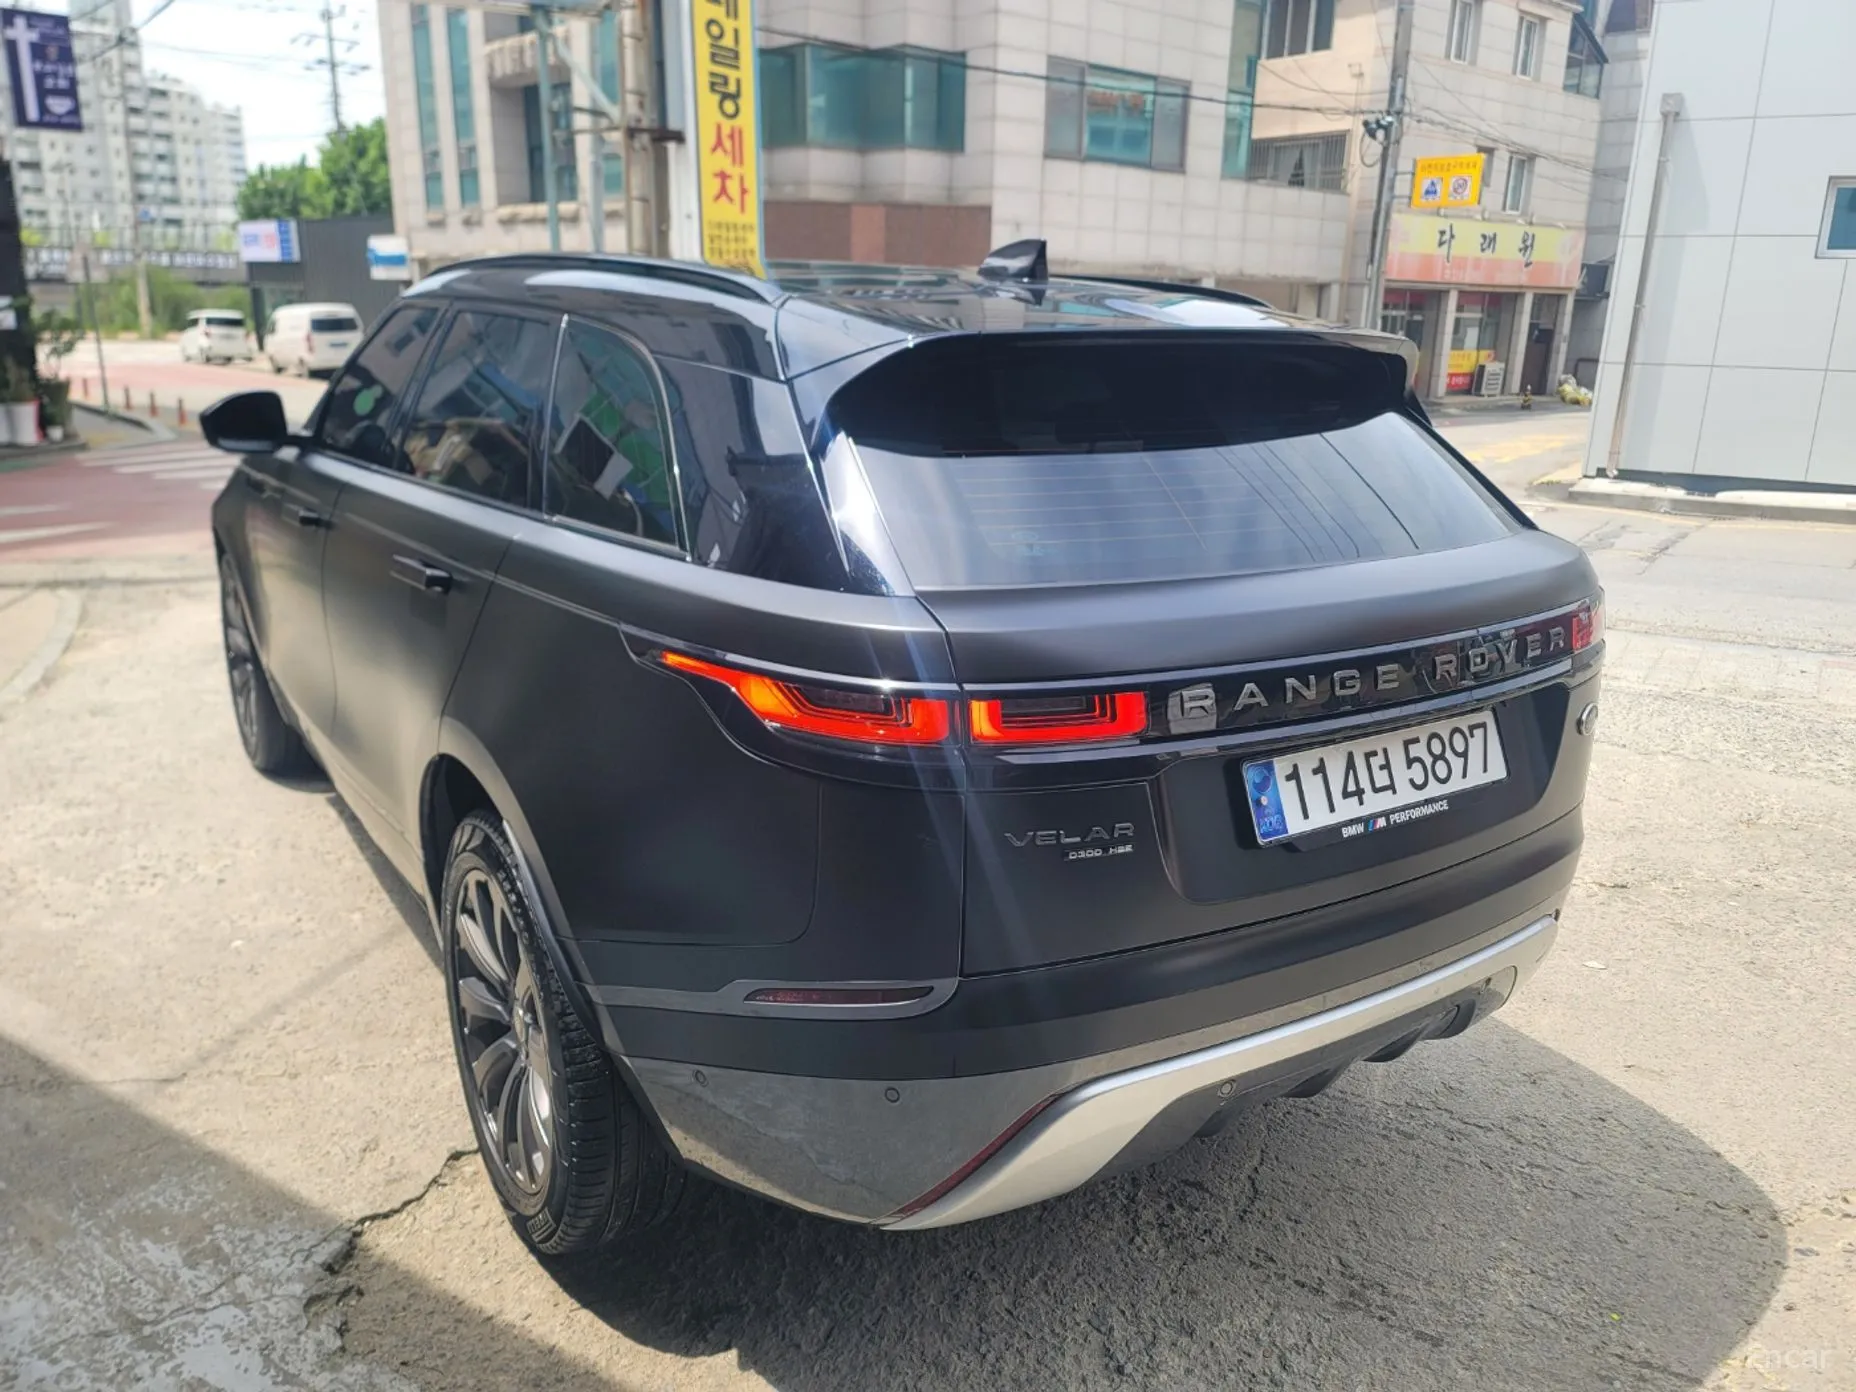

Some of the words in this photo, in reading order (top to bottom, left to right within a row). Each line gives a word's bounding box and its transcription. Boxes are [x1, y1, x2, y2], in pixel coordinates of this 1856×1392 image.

[710, 122, 749, 214] 세차
[1437, 223, 1537, 268] 다래원
[1180, 663, 1400, 719] RANGE
[1434, 626, 1566, 680] ROVER
[1285, 746, 1397, 820] 114더
[1403, 721, 1488, 792] 5897
[1003, 822, 1135, 847] VELAR
[1341, 823, 1365, 838] BMW
[1389, 799, 1449, 825] PERFORMANCE
[1068, 848, 1103, 860] D300
